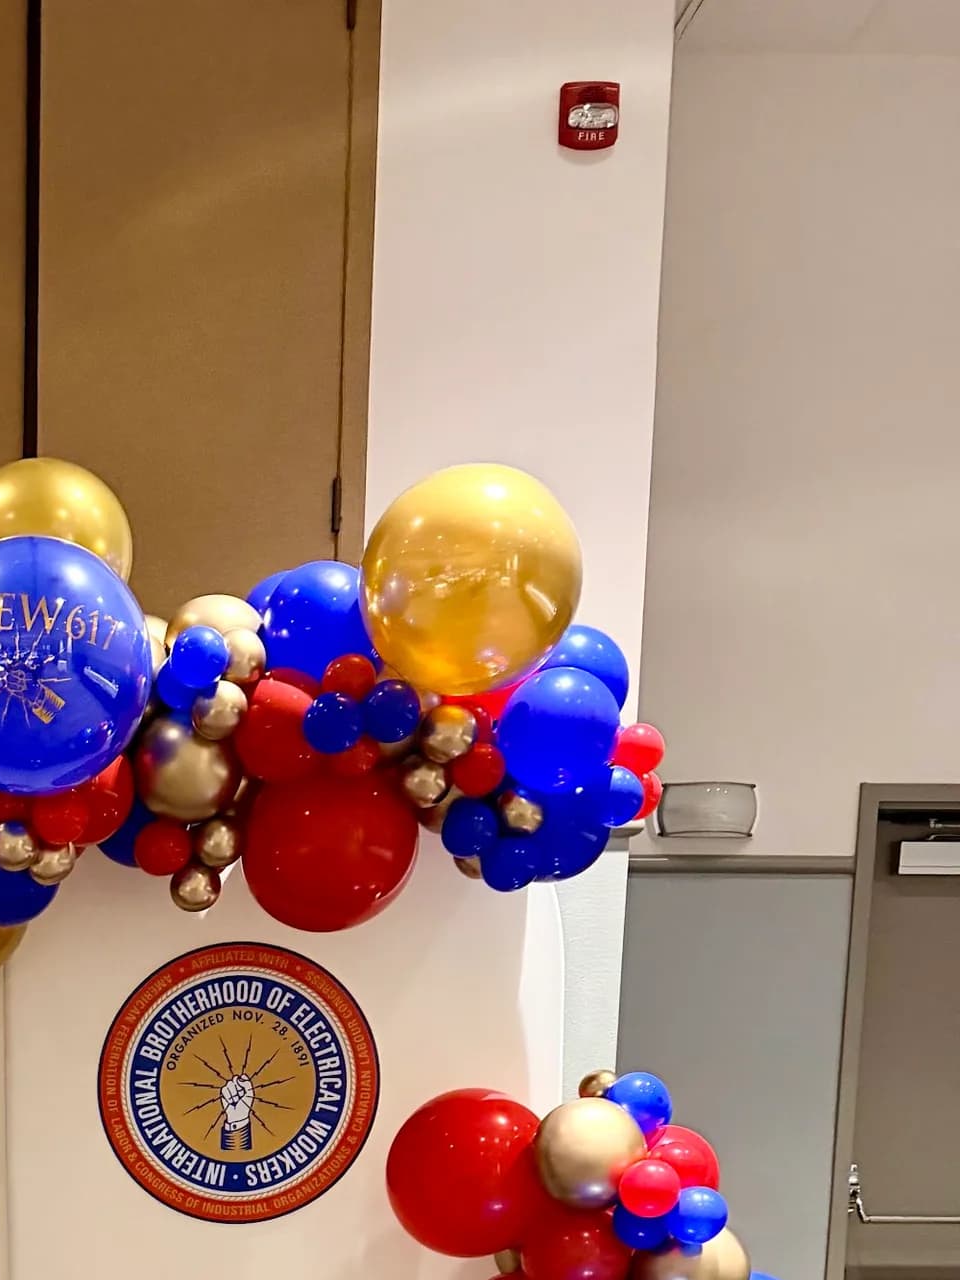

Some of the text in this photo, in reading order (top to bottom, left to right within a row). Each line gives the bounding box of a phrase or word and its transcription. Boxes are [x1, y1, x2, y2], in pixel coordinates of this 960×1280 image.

[578, 131, 605, 141] FIRE
[191, 950, 289, 970] AFFILIATED WITH
[166, 1010, 310, 1070] ORGANIZED NOV. 28, 1891
[105, 971, 372, 1216] AMERICAN FEDERATION OF LABOR & CONGRESS OF INDUSTRIAL ORGANIZATIONS & CANADIAN LABOUR CONGRESS
[134, 980, 342, 1187] INTERNATIONAL BROTHERHOOD OF ELECTRICAL WORKERS
